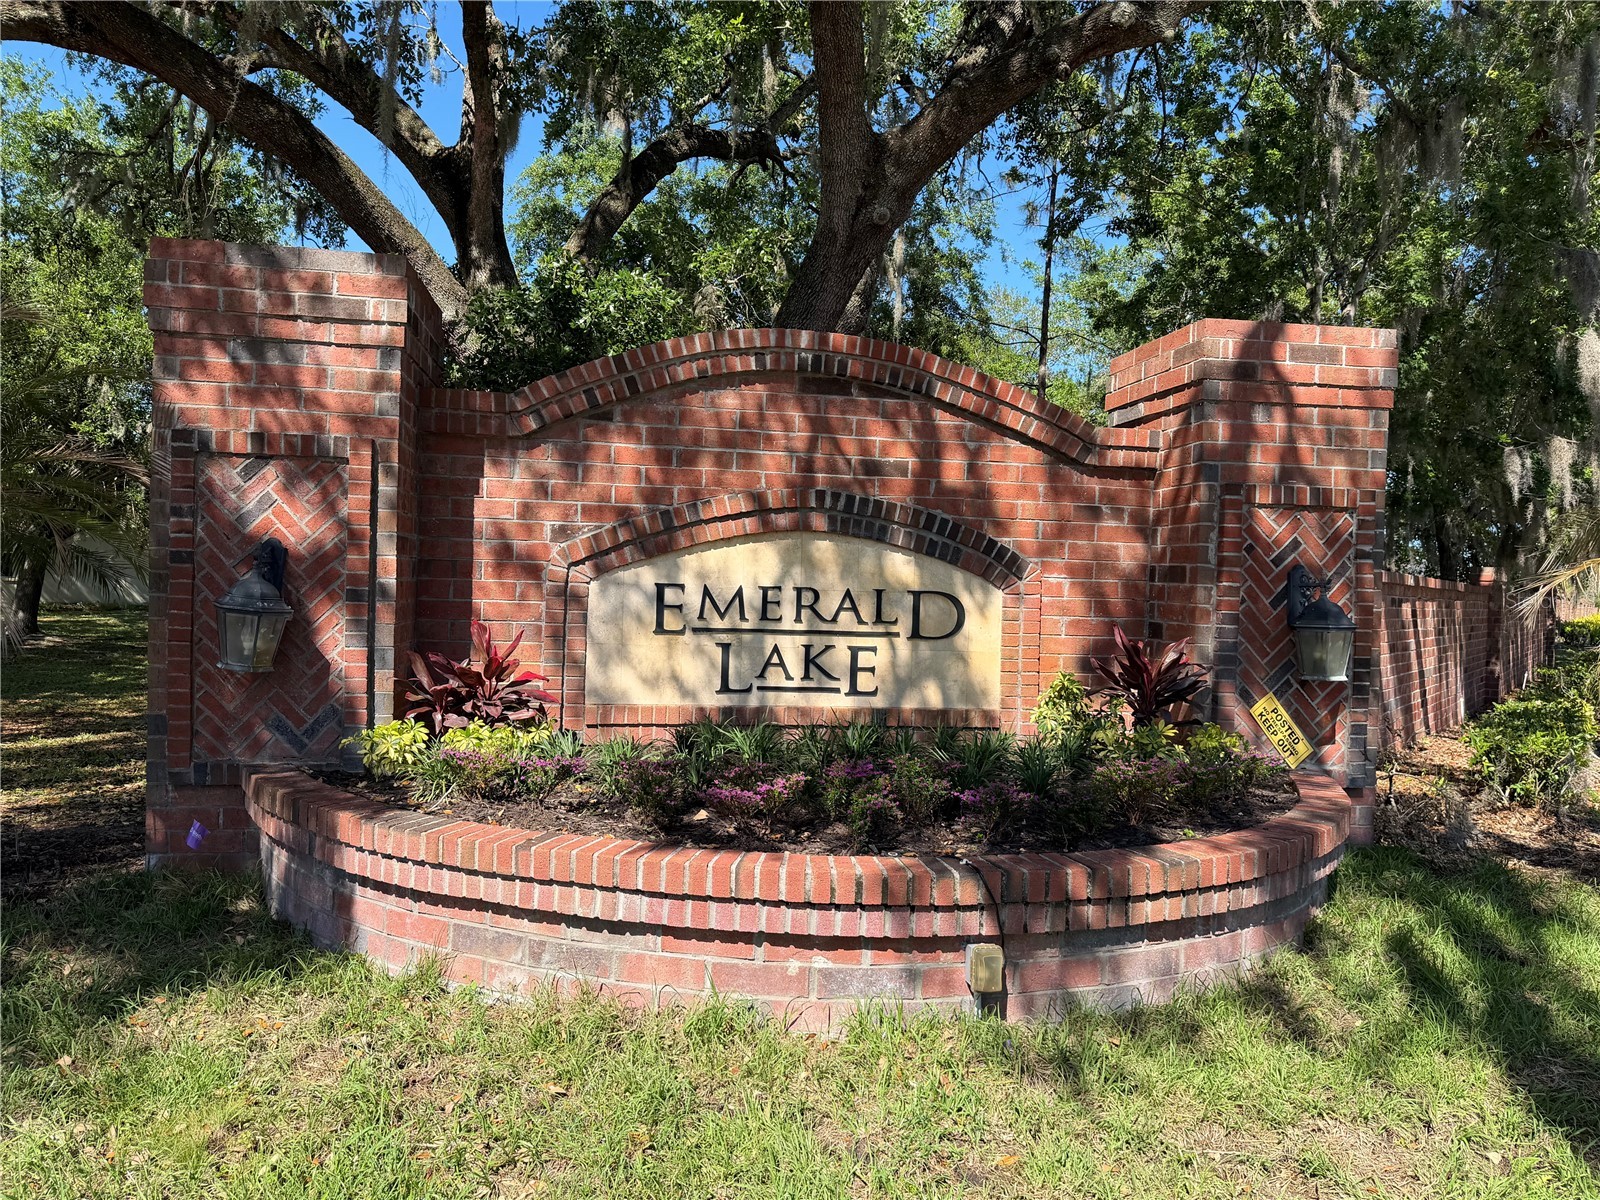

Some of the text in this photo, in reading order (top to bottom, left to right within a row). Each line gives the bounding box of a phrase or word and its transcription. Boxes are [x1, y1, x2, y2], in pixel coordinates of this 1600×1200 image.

[653, 582, 966, 641] EMERALD
[715, 642, 879, 697] LAKE
[1257, 711, 1295, 758] KEEP OUT
[1262, 706, 1299, 756] NO TRESPASSING
[1270, 707, 1300, 745] POSTED
